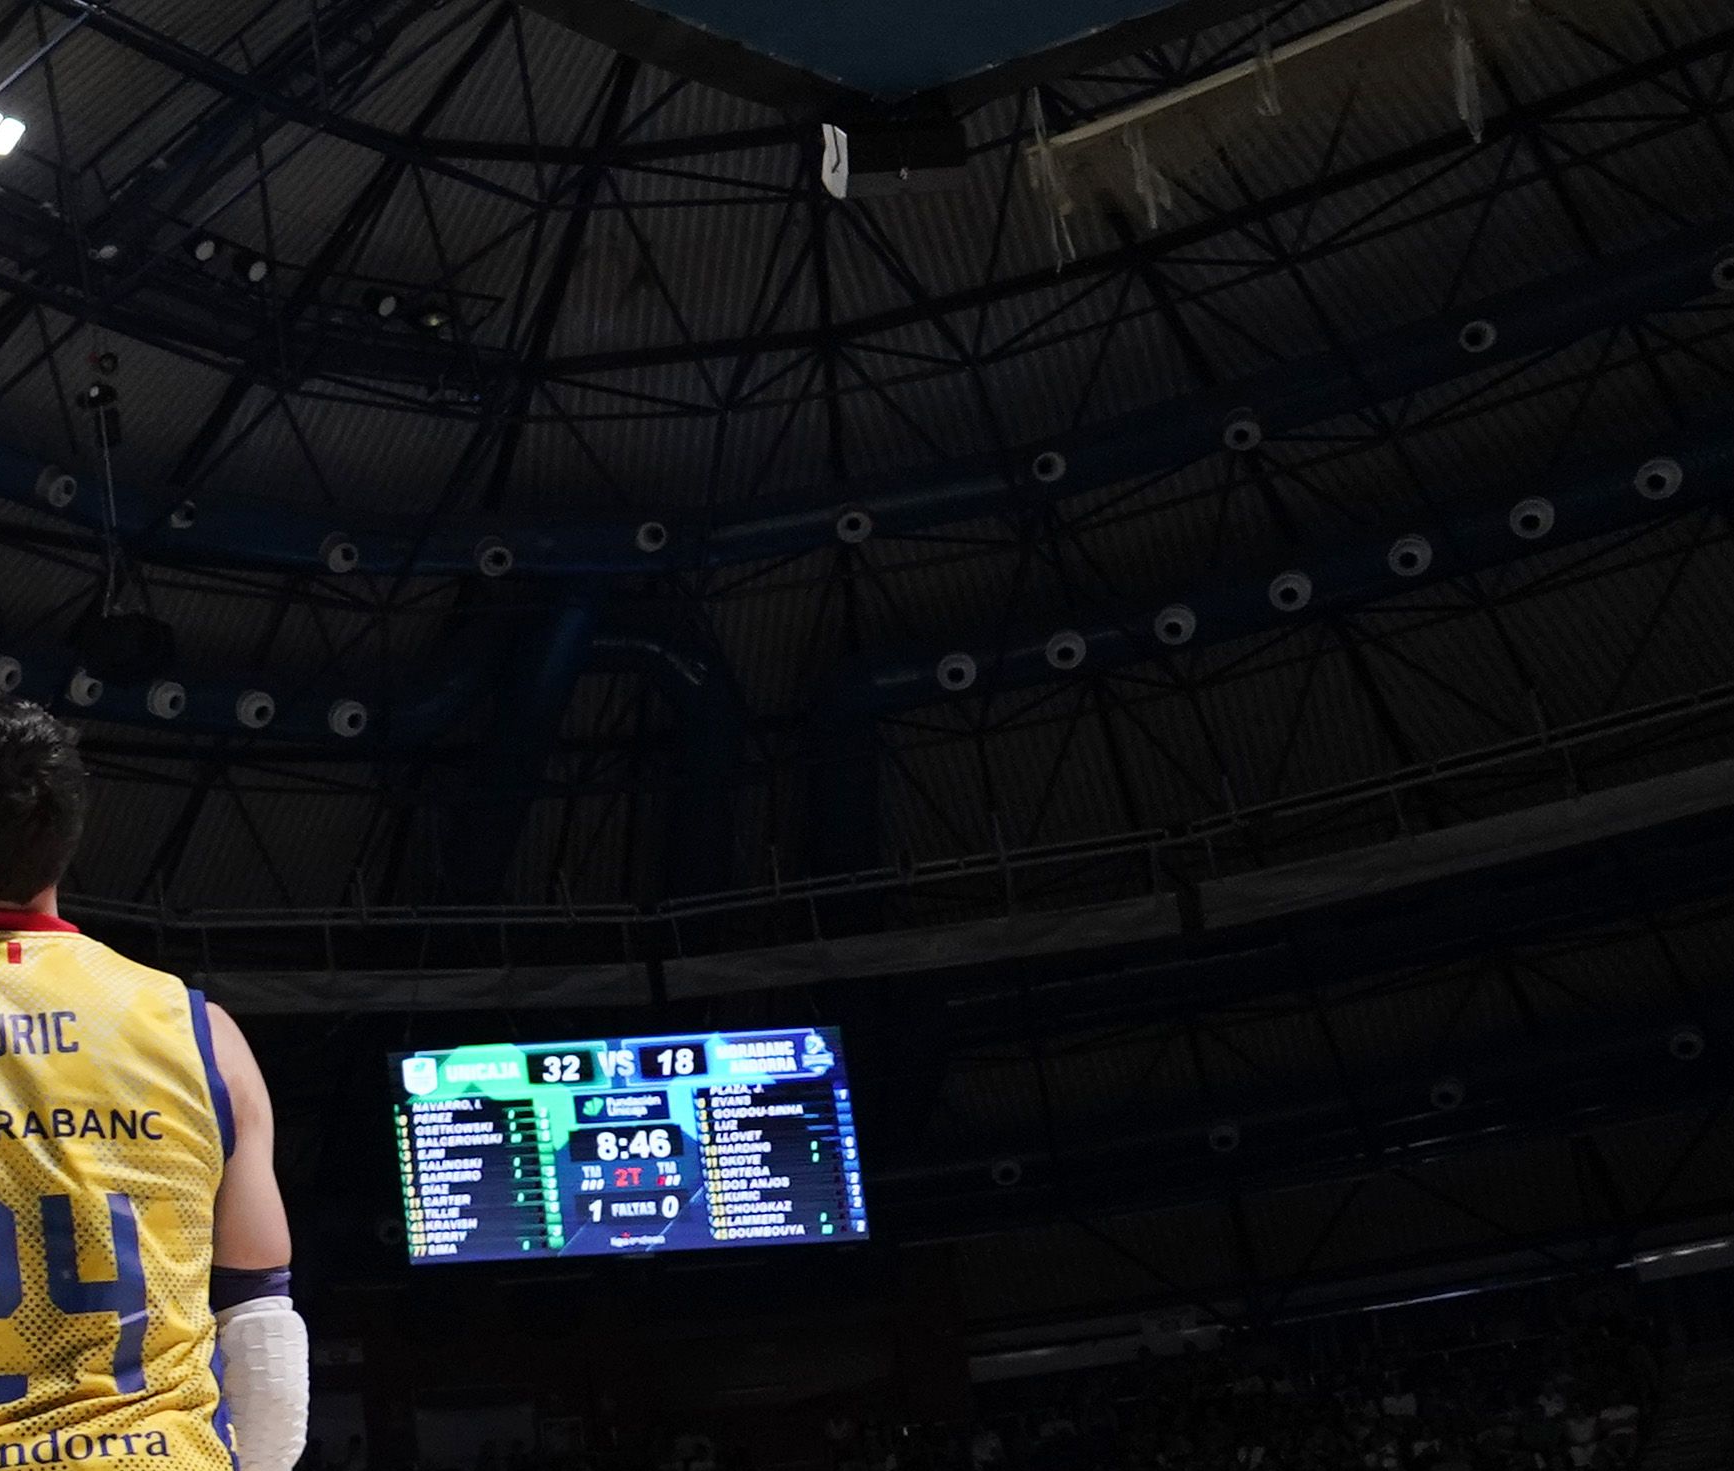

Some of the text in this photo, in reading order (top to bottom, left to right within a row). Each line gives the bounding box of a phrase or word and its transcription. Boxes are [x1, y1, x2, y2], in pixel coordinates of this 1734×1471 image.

[543, 1055, 581, 1081] 32
[598, 1049, 635, 1077] VS
[658, 1048, 694, 1076] 18
[597, 1129, 671, 1161] 8:46
[588, 1199, 603, 1222] 1
[661, 1195, 680, 1219] 0
